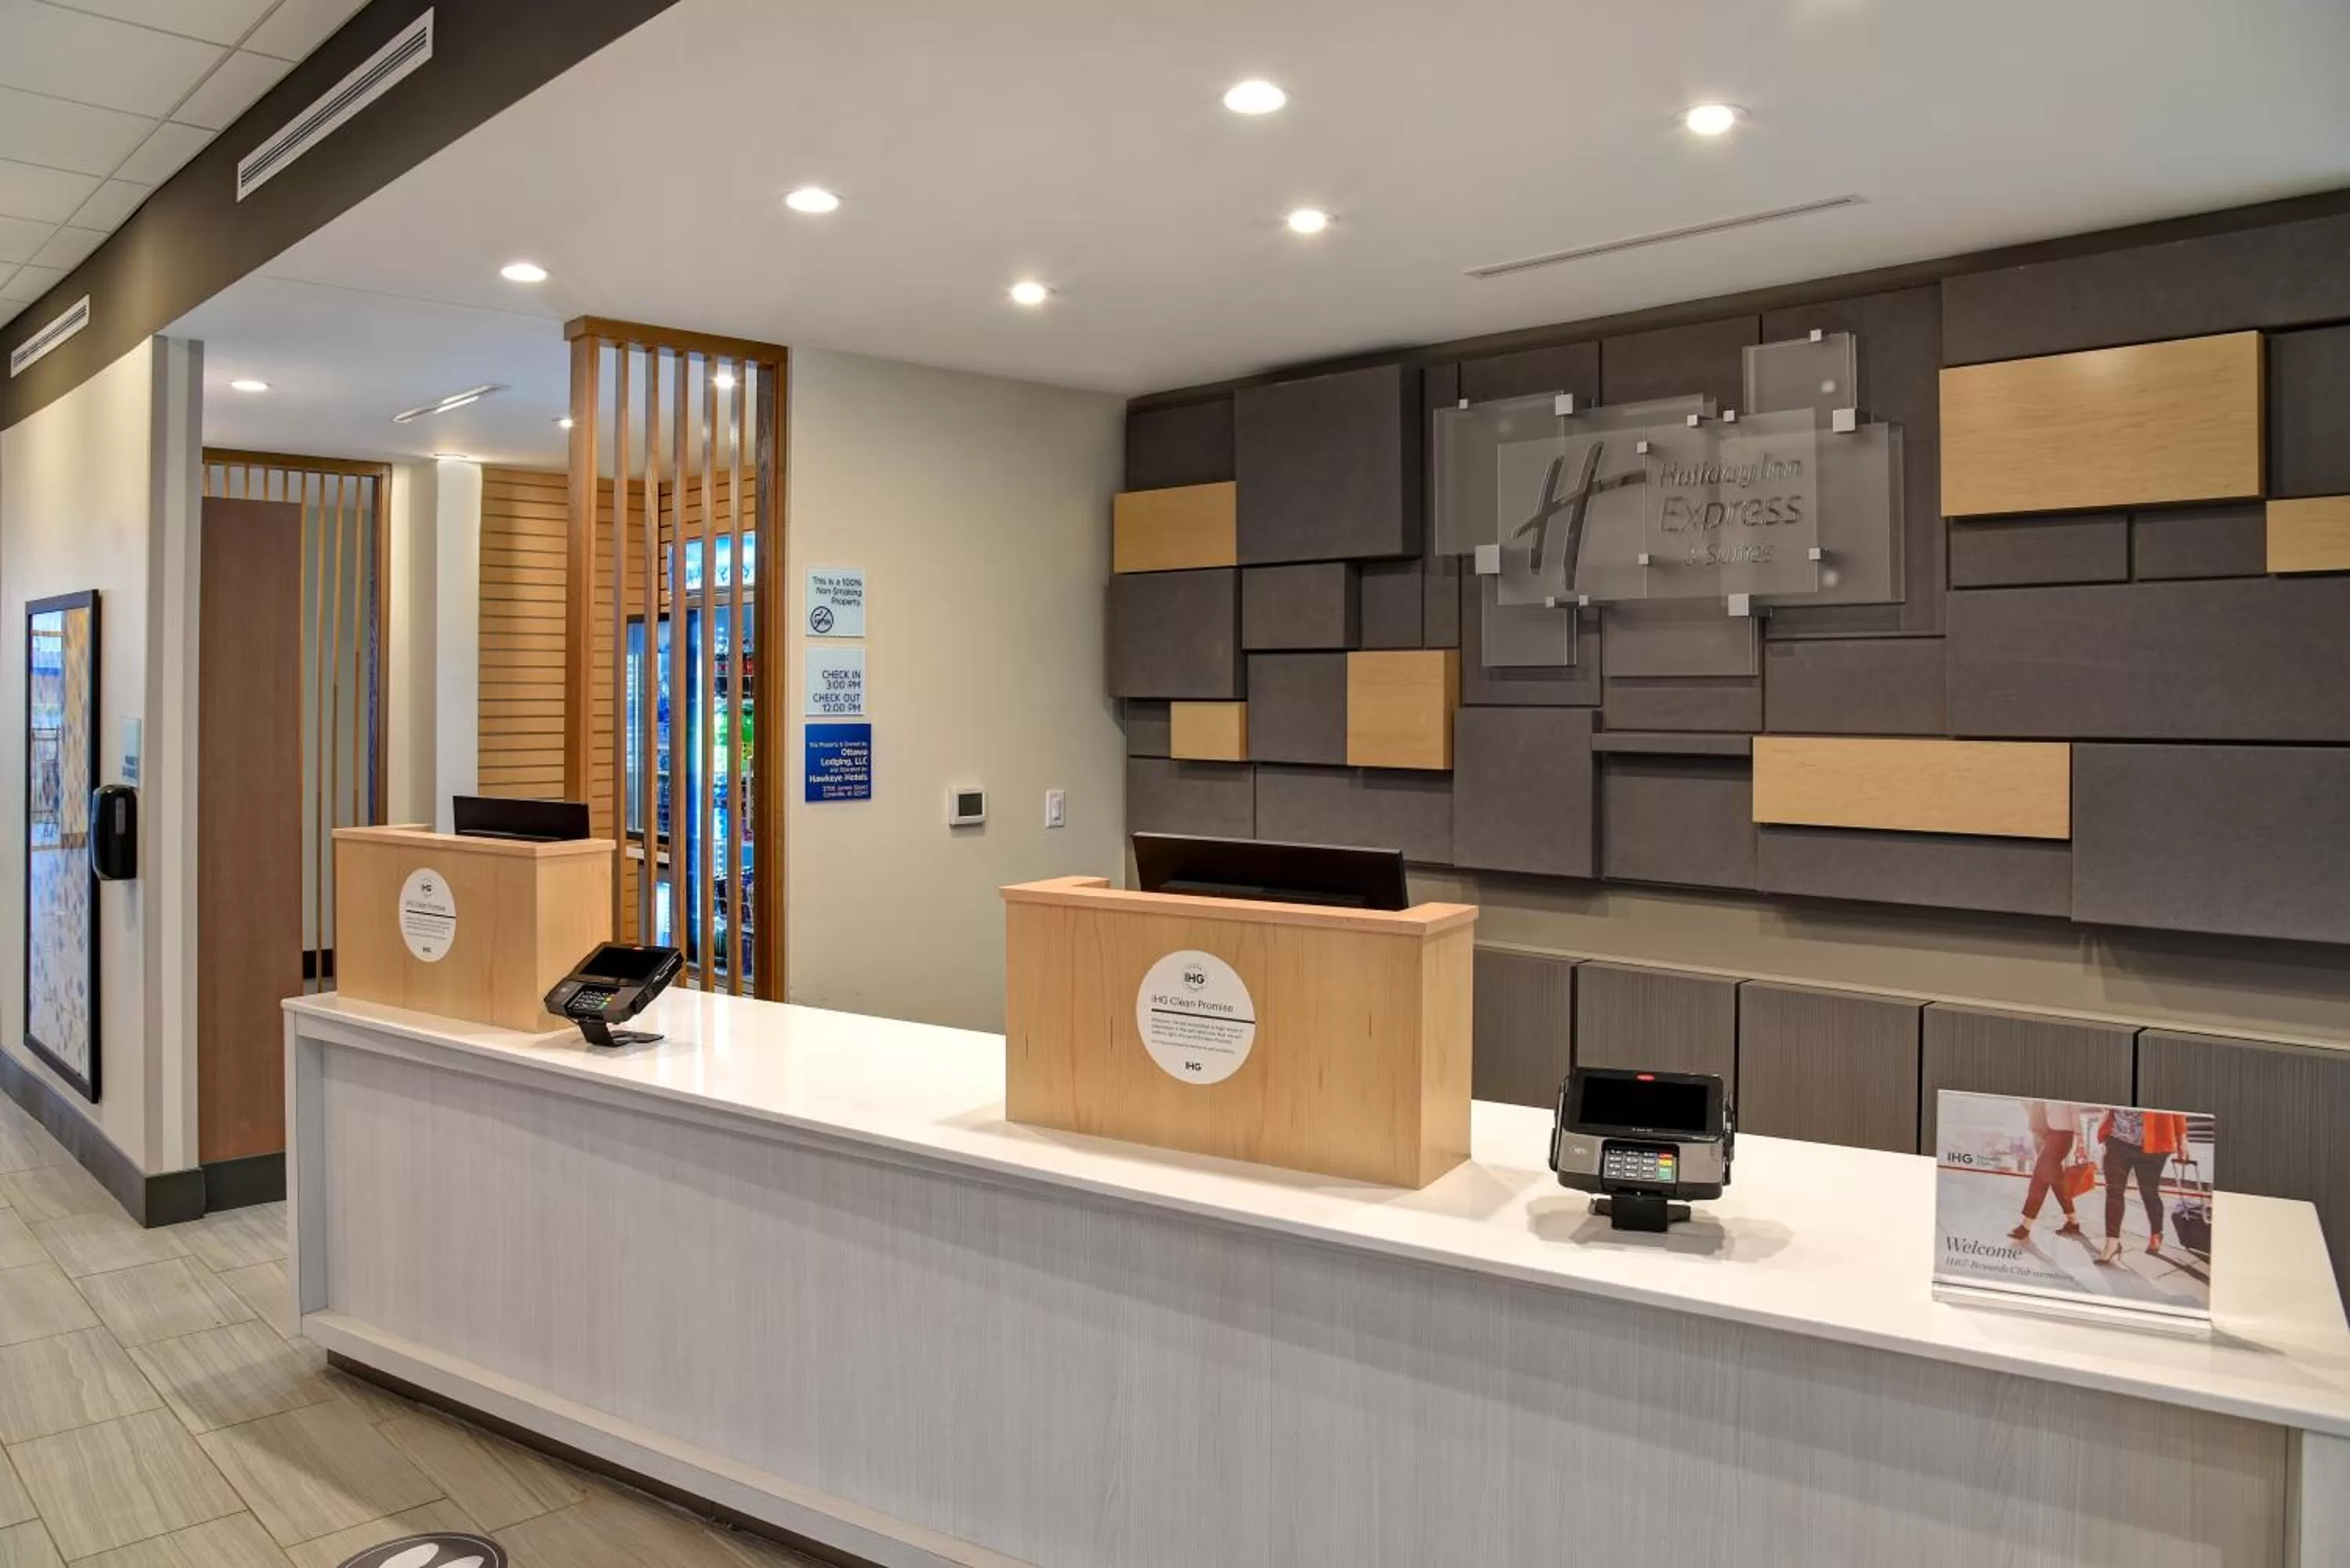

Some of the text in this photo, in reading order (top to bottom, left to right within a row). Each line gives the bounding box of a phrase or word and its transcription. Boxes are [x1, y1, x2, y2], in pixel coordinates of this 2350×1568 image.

[1658, 451, 1802, 490] Holiday Inn
[1659, 494, 1802, 538] Express
[1706, 542, 1773, 567] Suites
[812, 576, 826, 585] This
[842, 578, 862, 587] 100%
[822, 670, 861, 679] CHECK IN
[826, 679, 861, 690] 3:00 PM
[812, 692, 861, 703] CHECK OUT
[823, 703, 861, 713] 12:00 PM
[855, 756, 868, 765] LLC
[1184, 971, 1206, 985] IHG
[1152, 994, 1234, 1013] IHG Clean Promise
[1184, 1061, 1202, 1071] IHG
[1947, 1152, 1974, 1165] IHG
[1946, 1236, 2023, 1261] Welcome
